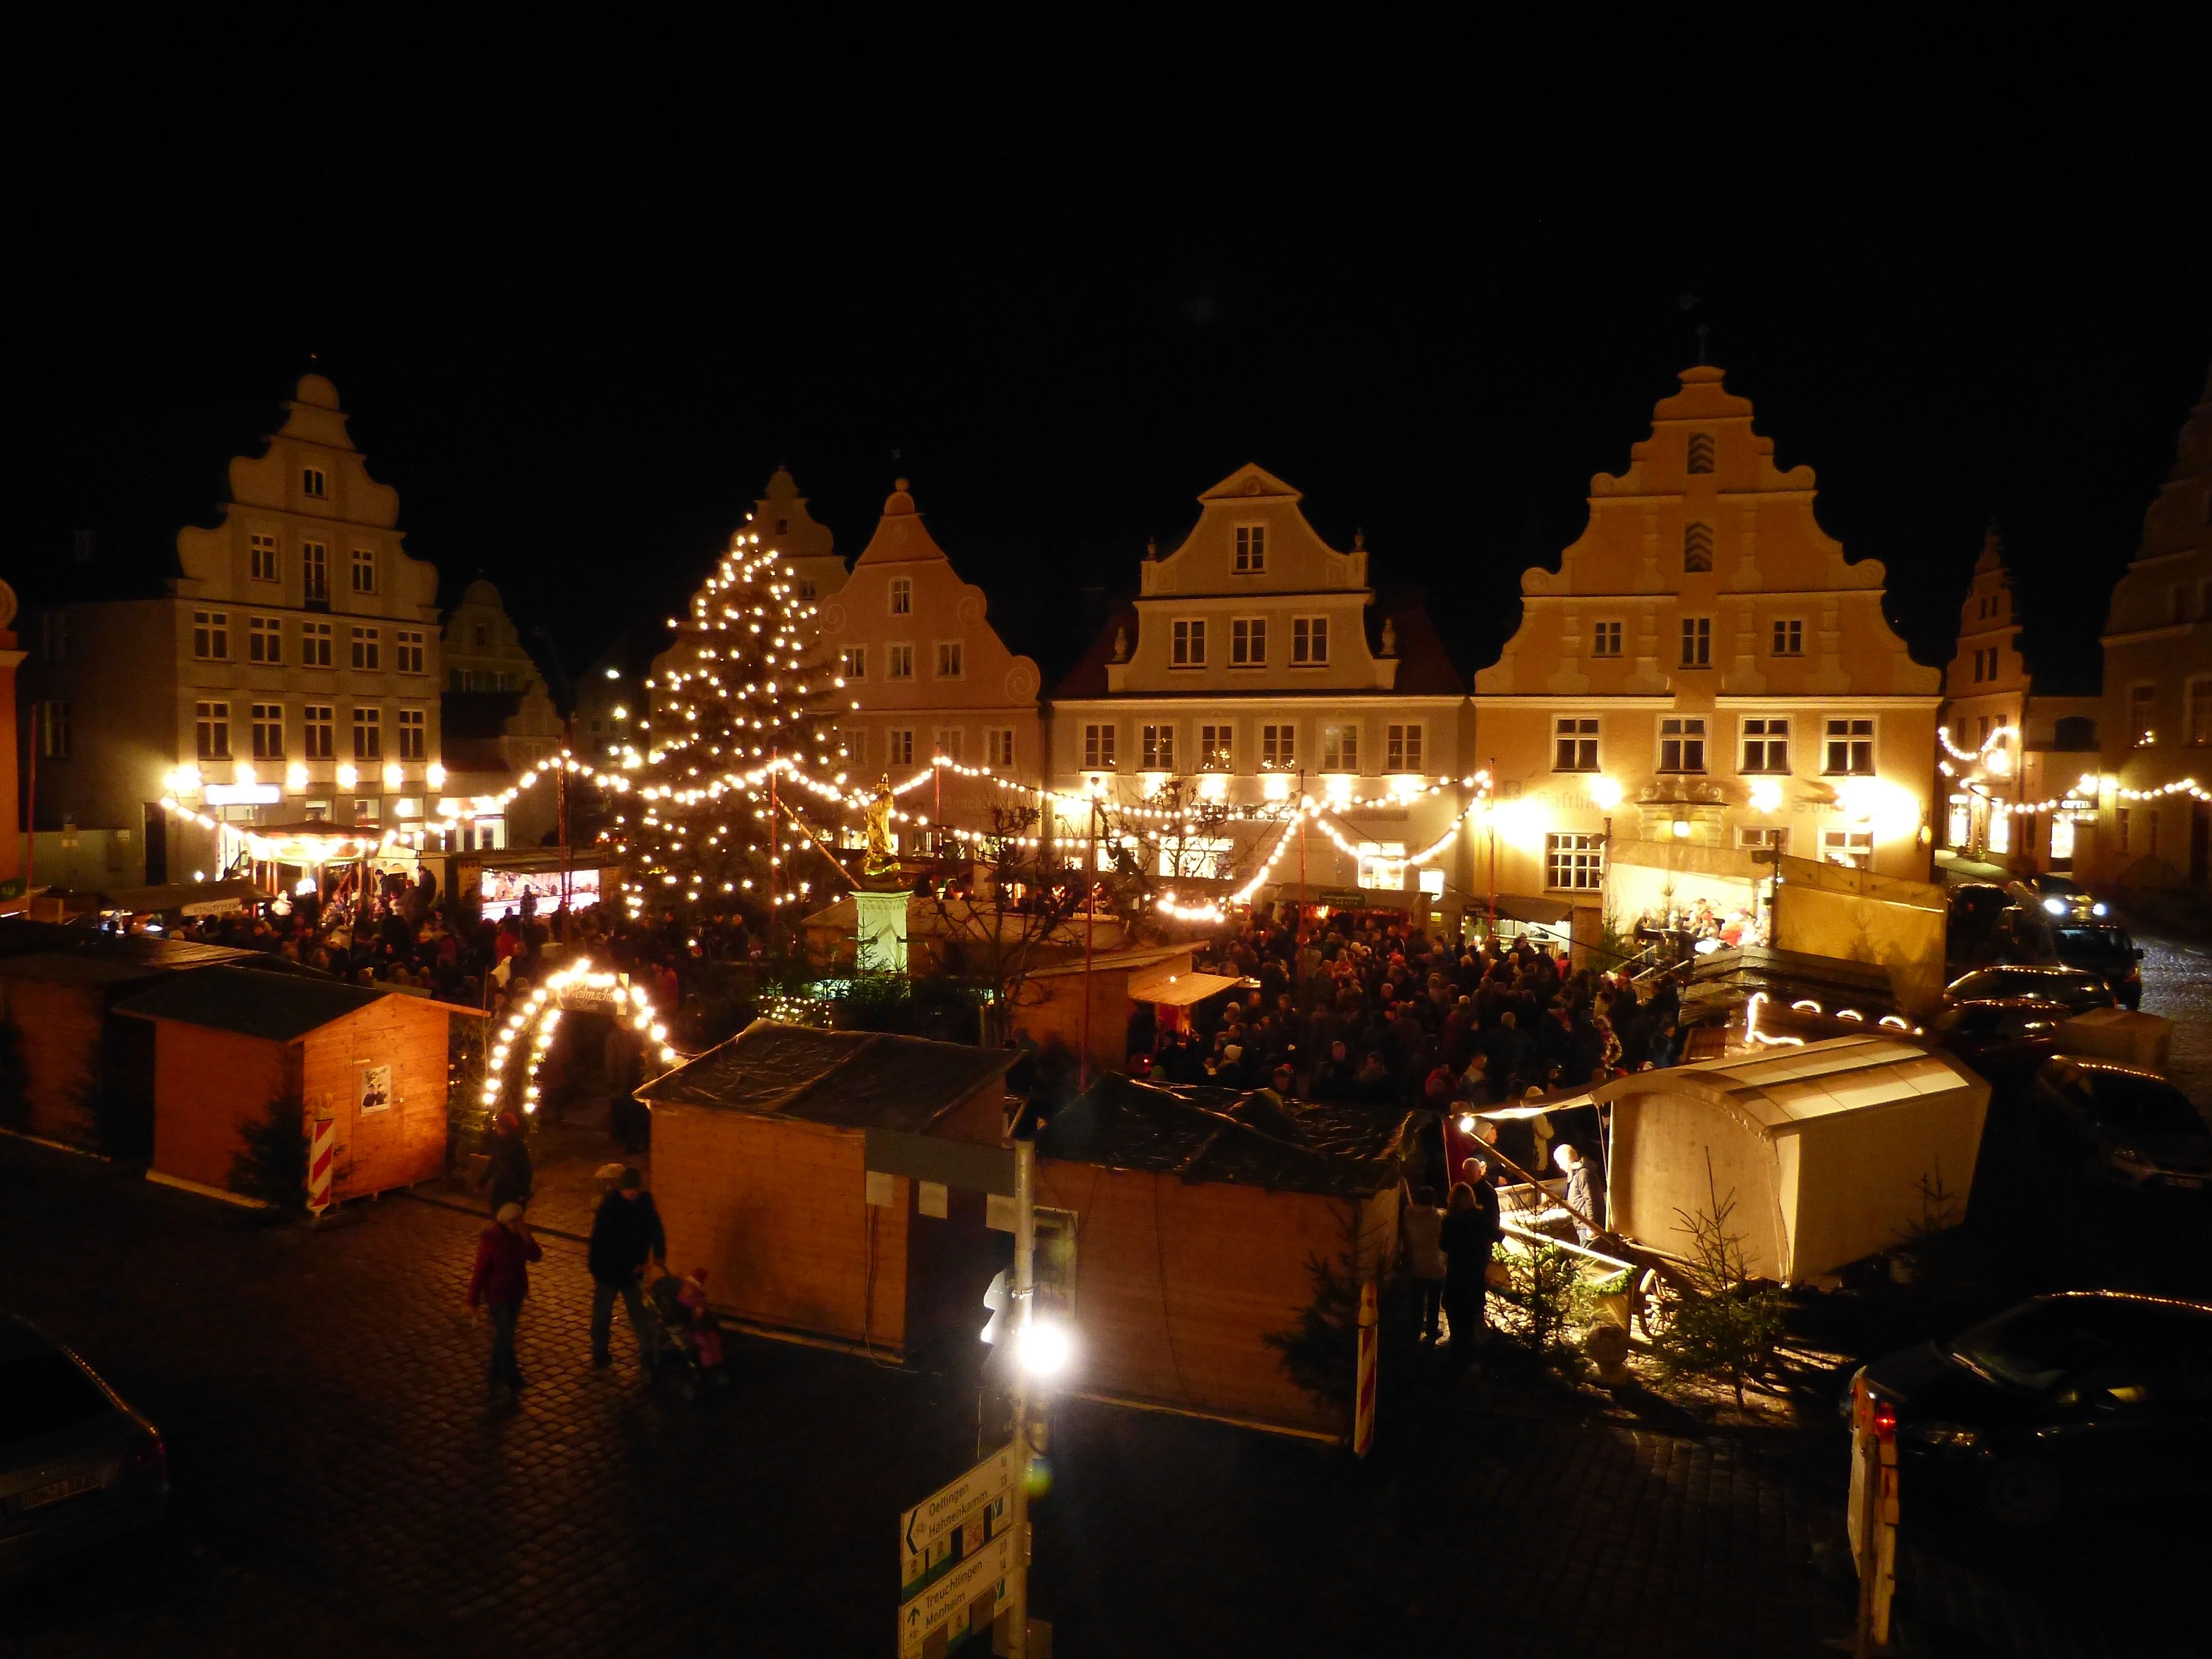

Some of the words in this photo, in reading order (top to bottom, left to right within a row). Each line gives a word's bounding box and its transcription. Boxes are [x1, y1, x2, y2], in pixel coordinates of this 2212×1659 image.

[2061, 800, 2091, 809] OPTIK
[928, 1490, 987, 1538] Hahnenkamm
[929, 1483, 969, 1516] Oettingen
[926, 1561, 982, 1609] Treuchtlingen
[926, 1592, 965, 1629] Monheim
